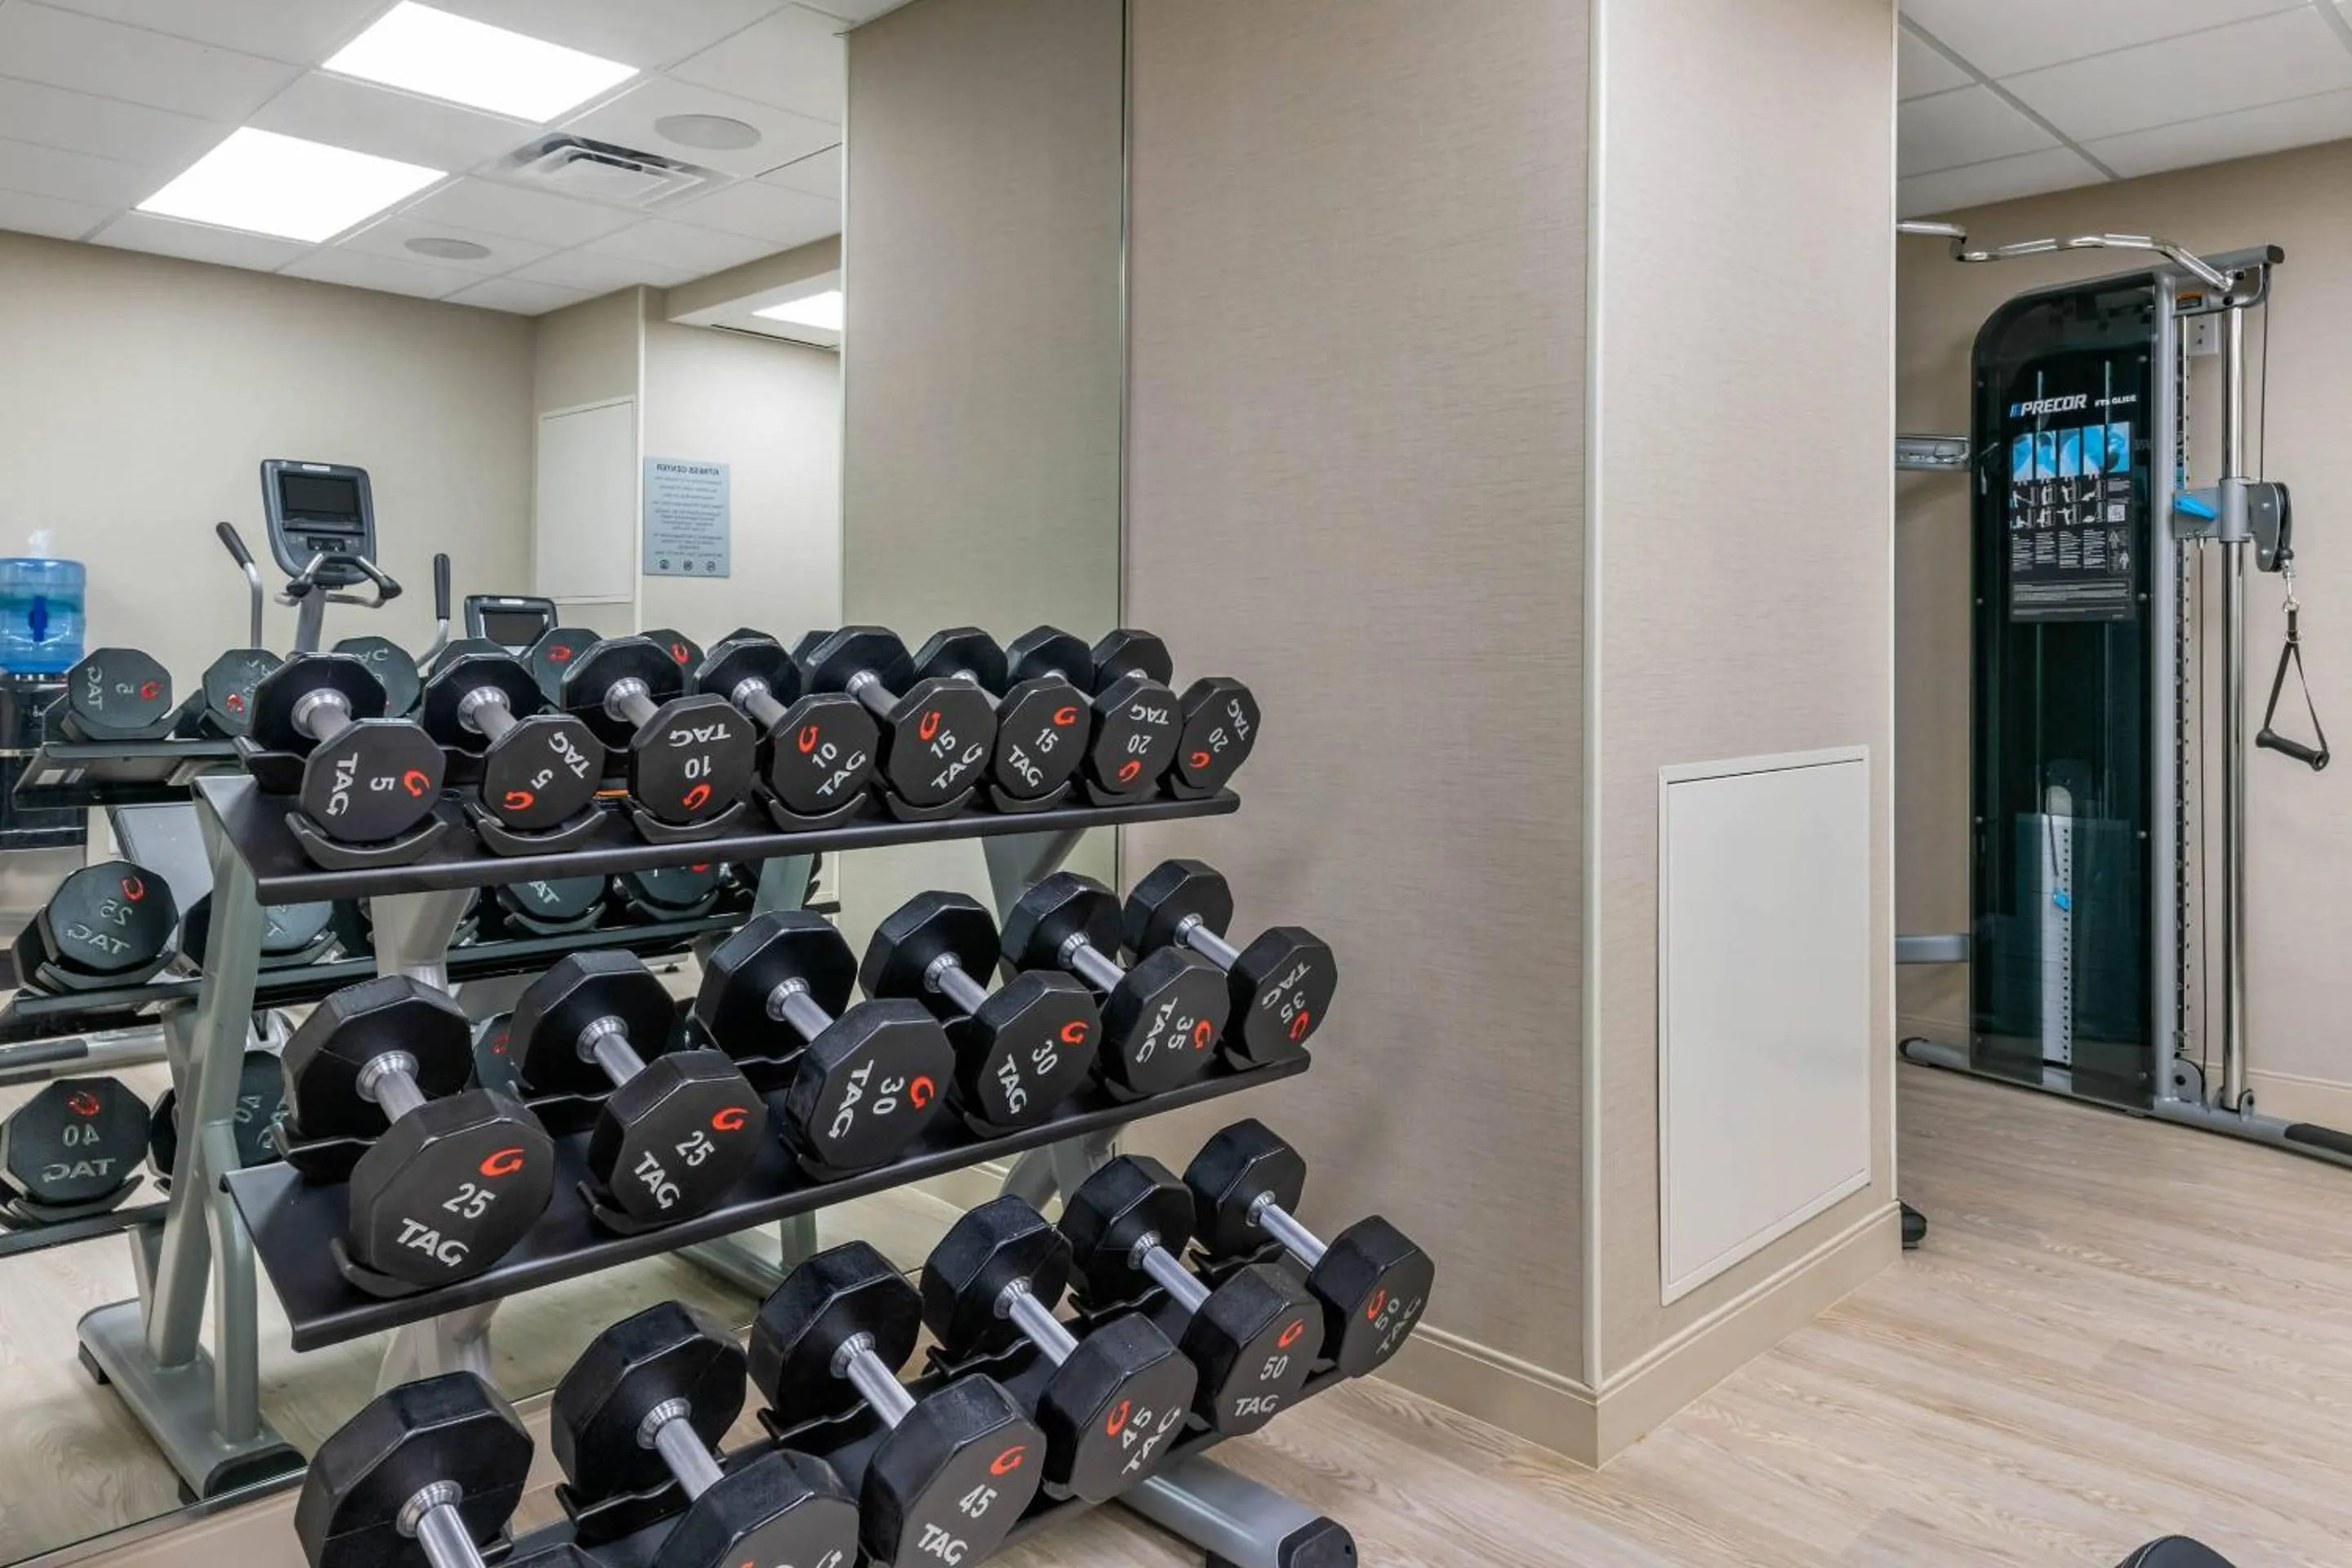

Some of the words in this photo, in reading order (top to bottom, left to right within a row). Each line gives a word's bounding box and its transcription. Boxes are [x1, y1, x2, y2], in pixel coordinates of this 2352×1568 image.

[2020, 394, 2087, 416] PRECOR
[1130, 704, 1169, 724] TAG
[1226, 699, 1248, 741] TAG
[549, 731, 591, 778] TAG
[668, 724, 732, 748] TAG
[930, 730, 956, 758] 15
[1035, 728, 1058, 753] 15
[1127, 733, 1151, 755] 20
[1209, 728, 1230, 752] 20
[684, 756, 711, 779] 10
[811, 742, 838, 770] 10
[817, 750, 866, 798] TAG
[931, 743, 982, 791] TAG
[1008, 746, 1043, 787] TAG
[327, 753, 359, 816] TAG
[370, 777, 394, 791] 5
[531, 769, 553, 789] 5
[1261, 960, 1311, 1009] TAG
[1280, 990, 1307, 1025] 35
[1135, 996, 1178, 1064] TAG
[1166, 1016, 1194, 1050] 35
[1031, 1040, 1059, 1076] 30
[828, 1059, 874, 1140] TAG
[873, 1076, 905, 1116] 30
[997, 1054, 1028, 1114] TAG
[675, 1130, 715, 1167] 25
[634, 1152, 679, 1209] TAG
[443, 1183, 496, 1220] 25
[395, 1218, 470, 1267] TAG
[1374, 1298, 1400, 1331] 50
[1376, 1298, 1422, 1356] TAG
[1259, 1355, 1290, 1381] 50
[1233, 1394, 1280, 1418] TAG
[1121, 1407, 1152, 1450] 45
[1121, 1406, 1182, 1477] TAG
[958, 1485, 998, 1519] 45
[917, 1523, 969, 1566] TAG
